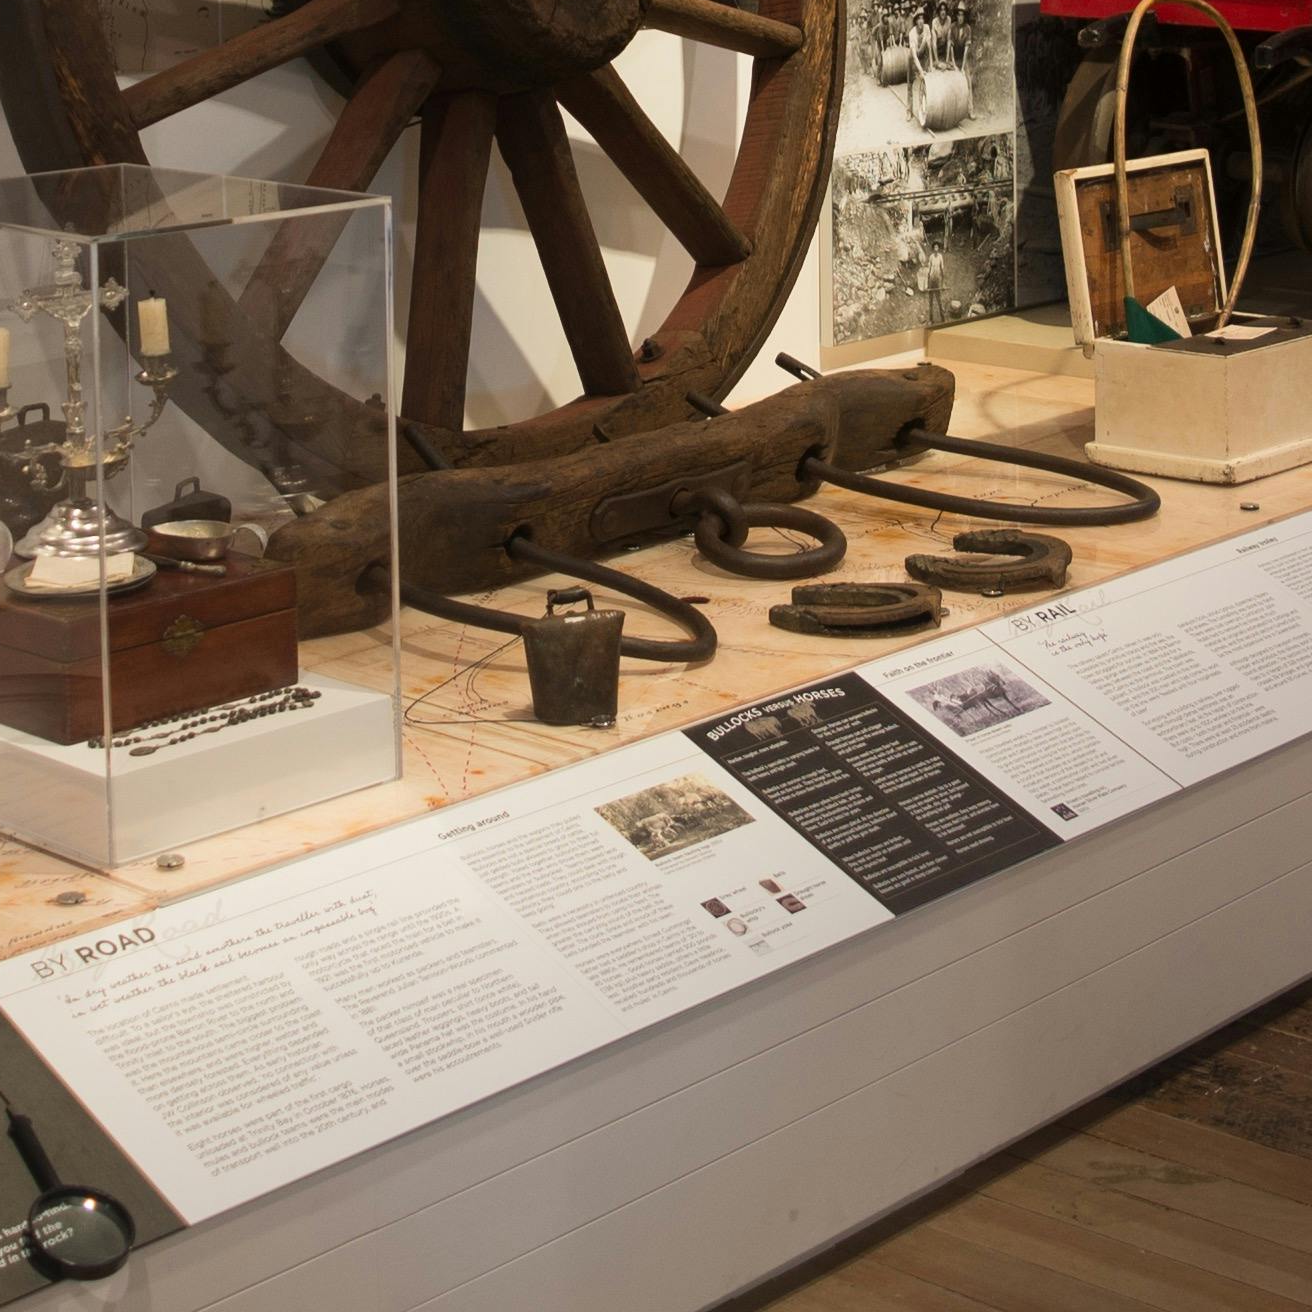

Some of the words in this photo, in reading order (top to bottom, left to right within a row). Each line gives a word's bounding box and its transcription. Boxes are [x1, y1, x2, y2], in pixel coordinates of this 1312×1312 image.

[1011, 615, 1036, 631] BY
[1035, 603, 1076, 623] RAIL
[882, 666, 903, 679] Faith
[903, 664, 913, 673] on
[912, 658, 926, 671] the
[926, 650, 954, 665] frontier
[706, 707, 763, 741] BULLOCKS
[762, 699, 795, 715] VERSUS
[793, 688, 846, 704] HORSES
[438, 824, 476, 840] Getting
[476, 811, 510, 827] around
[30, 953, 67, 979] BY
[75, 928, 155, 963] ROAD
[85, 988, 107, 998] dry
[110, 972, 151, 989] weather
[153, 963, 171, 973] the
[176, 952, 202, 966] sand
[254, 928, 272, 936] the
[274, 911, 320, 930] traveller
[324, 900, 346, 912] with
[89, 999, 108, 1012] wet
[114, 986, 154, 1003] weather
[157, 978, 175, 987] the
[178, 964, 209, 980] black
[214, 954, 234, 968] soil
[238, 942, 279, 959] becomes
[7, 1254, 20, 1264] in
[42, 1227, 74, 1249] rock?
[42, 1221, 63, 1235] the
